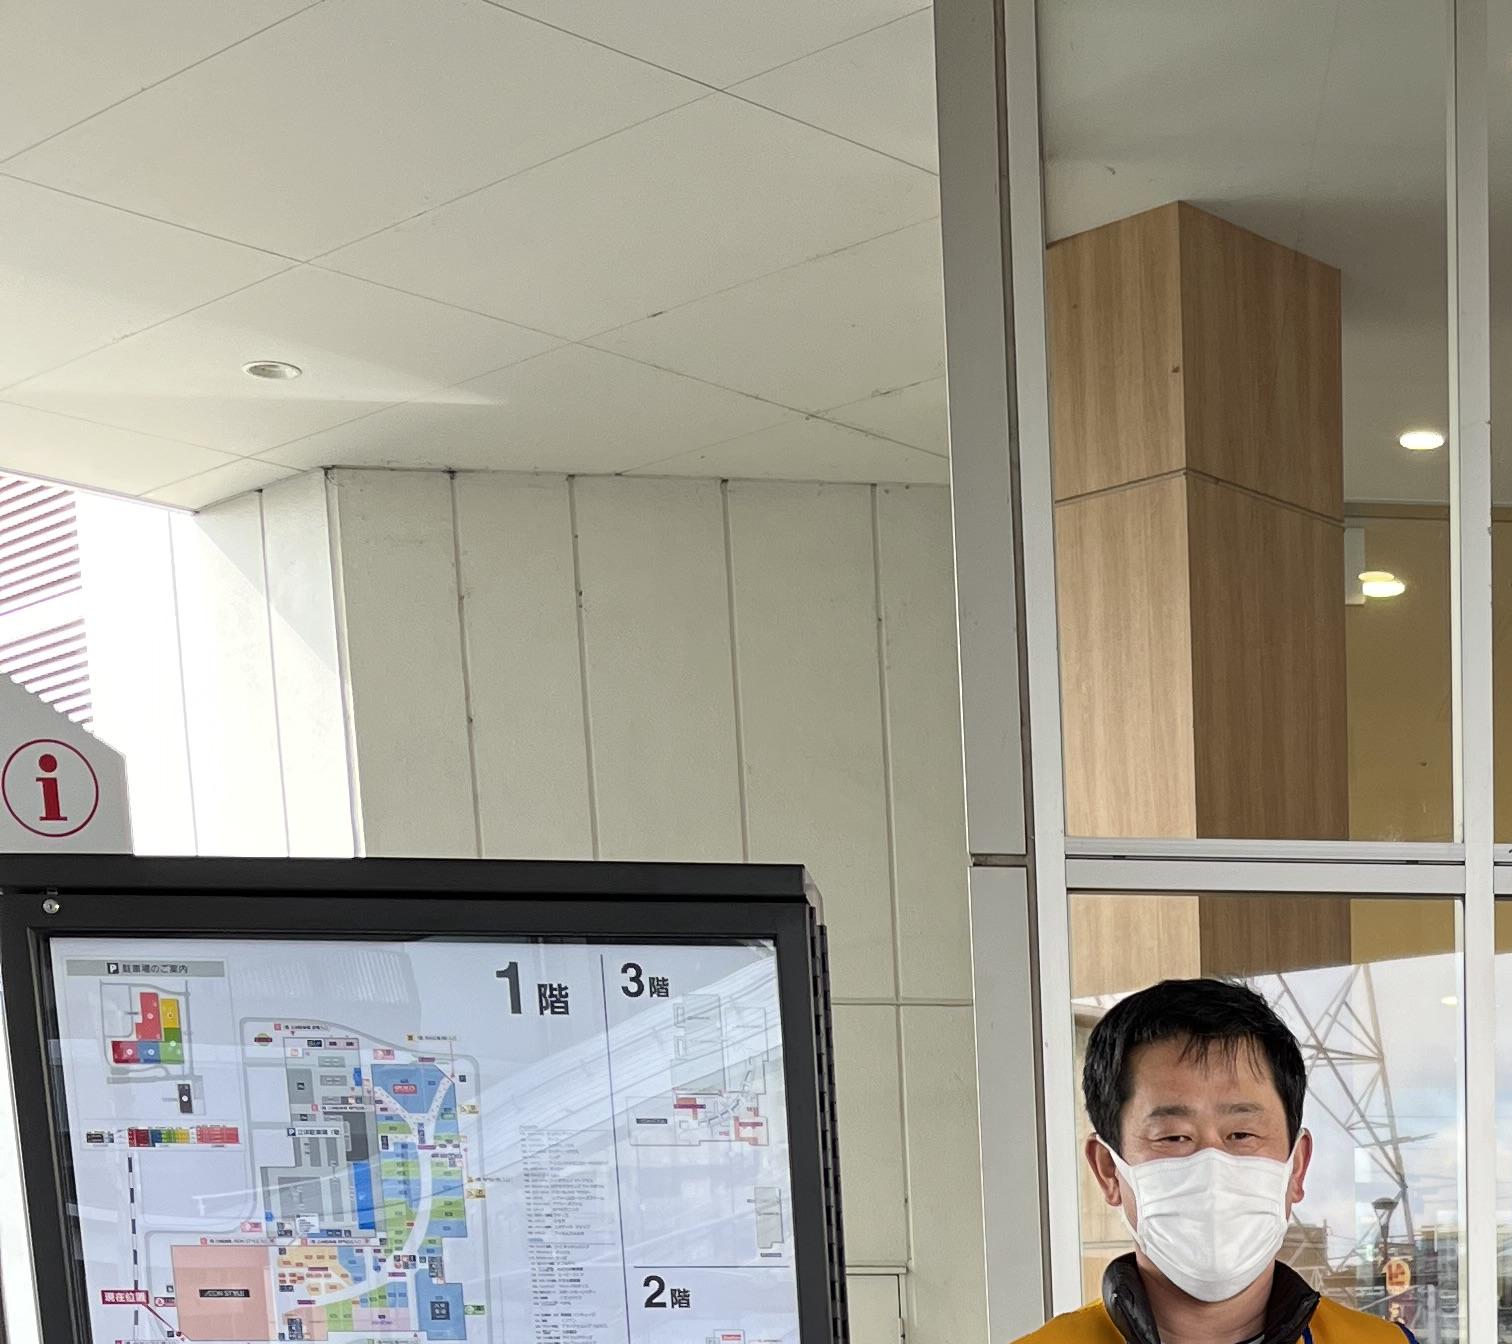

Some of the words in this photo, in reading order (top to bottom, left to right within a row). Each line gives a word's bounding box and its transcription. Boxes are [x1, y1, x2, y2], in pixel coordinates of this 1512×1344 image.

[496, 961, 570, 1016] 1階
[621, 962, 670, 998] 3階
[643, 1275, 691, 1309] 2階
